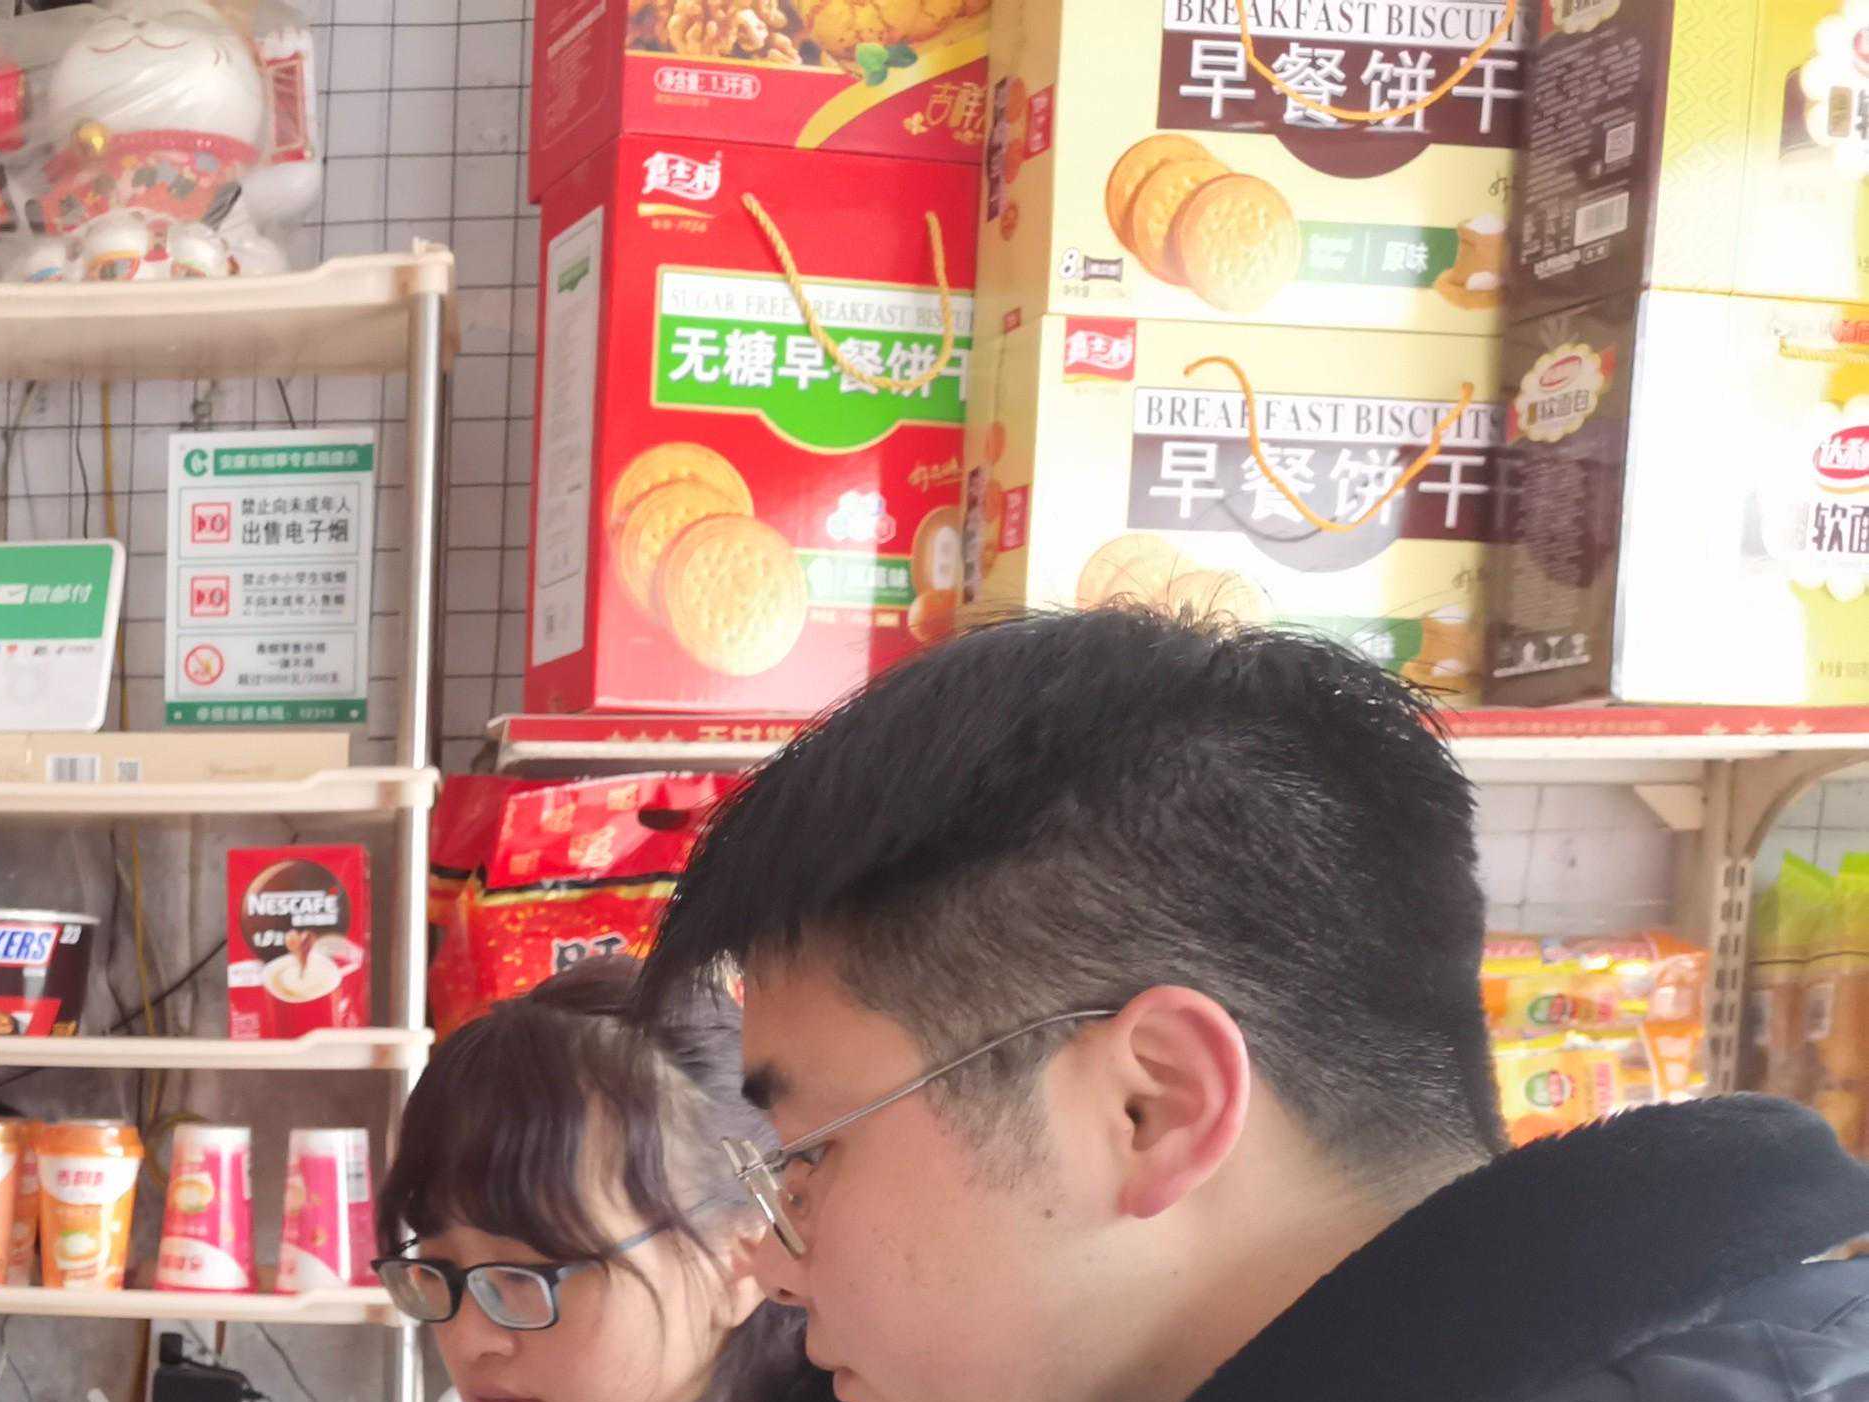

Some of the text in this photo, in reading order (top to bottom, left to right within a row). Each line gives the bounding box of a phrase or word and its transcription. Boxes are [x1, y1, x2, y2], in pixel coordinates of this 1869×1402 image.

[1179, 39, 1524, 134] 早餐饼干
[1381, 241, 1429, 274] 原味
[1148, 440, 1491, 530] 早餐饼干
[242, 496, 351, 516] 禁止向未成年人
[242, 519, 349, 545] 出售电子烟
